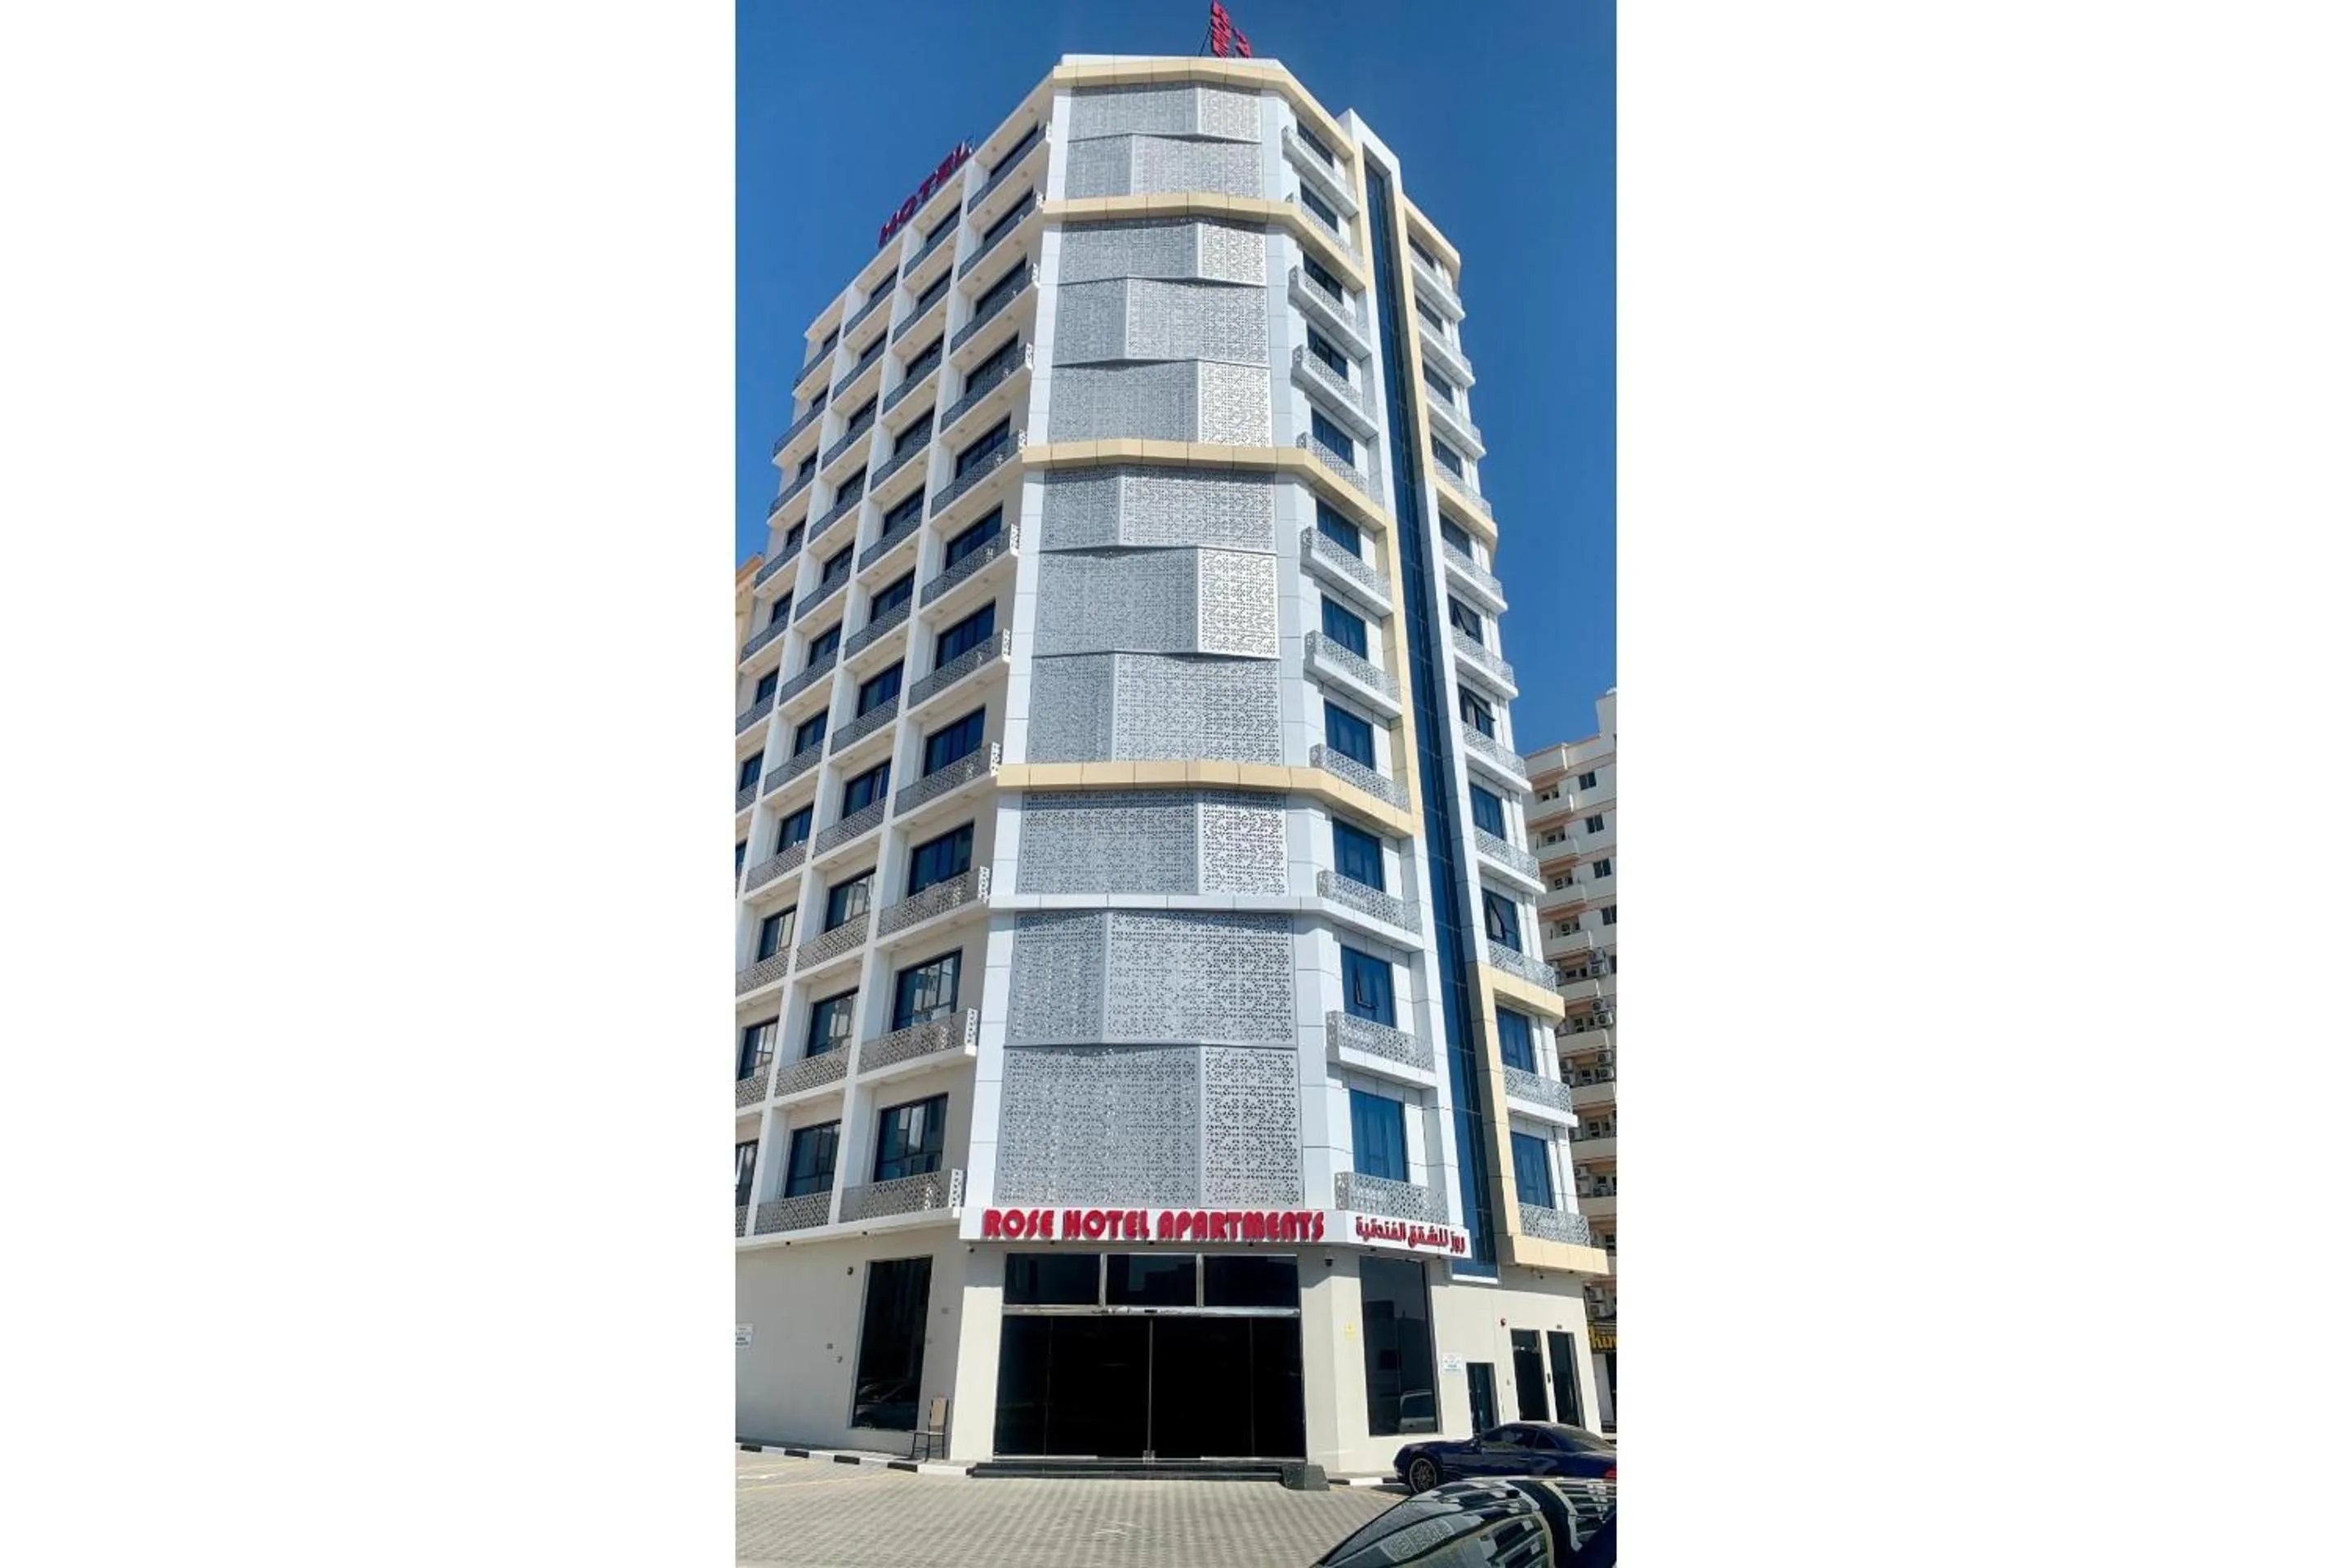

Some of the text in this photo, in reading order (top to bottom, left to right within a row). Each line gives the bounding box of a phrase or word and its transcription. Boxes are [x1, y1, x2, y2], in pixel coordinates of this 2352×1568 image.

[877, 139, 973, 248] HOTEL
[982, 1209, 1324, 1241] ROSE HOTEL APARTMENTS
[1408, 1225, 1448, 1247] للشقق
[1450, 1232, 1465, 1254] روز
